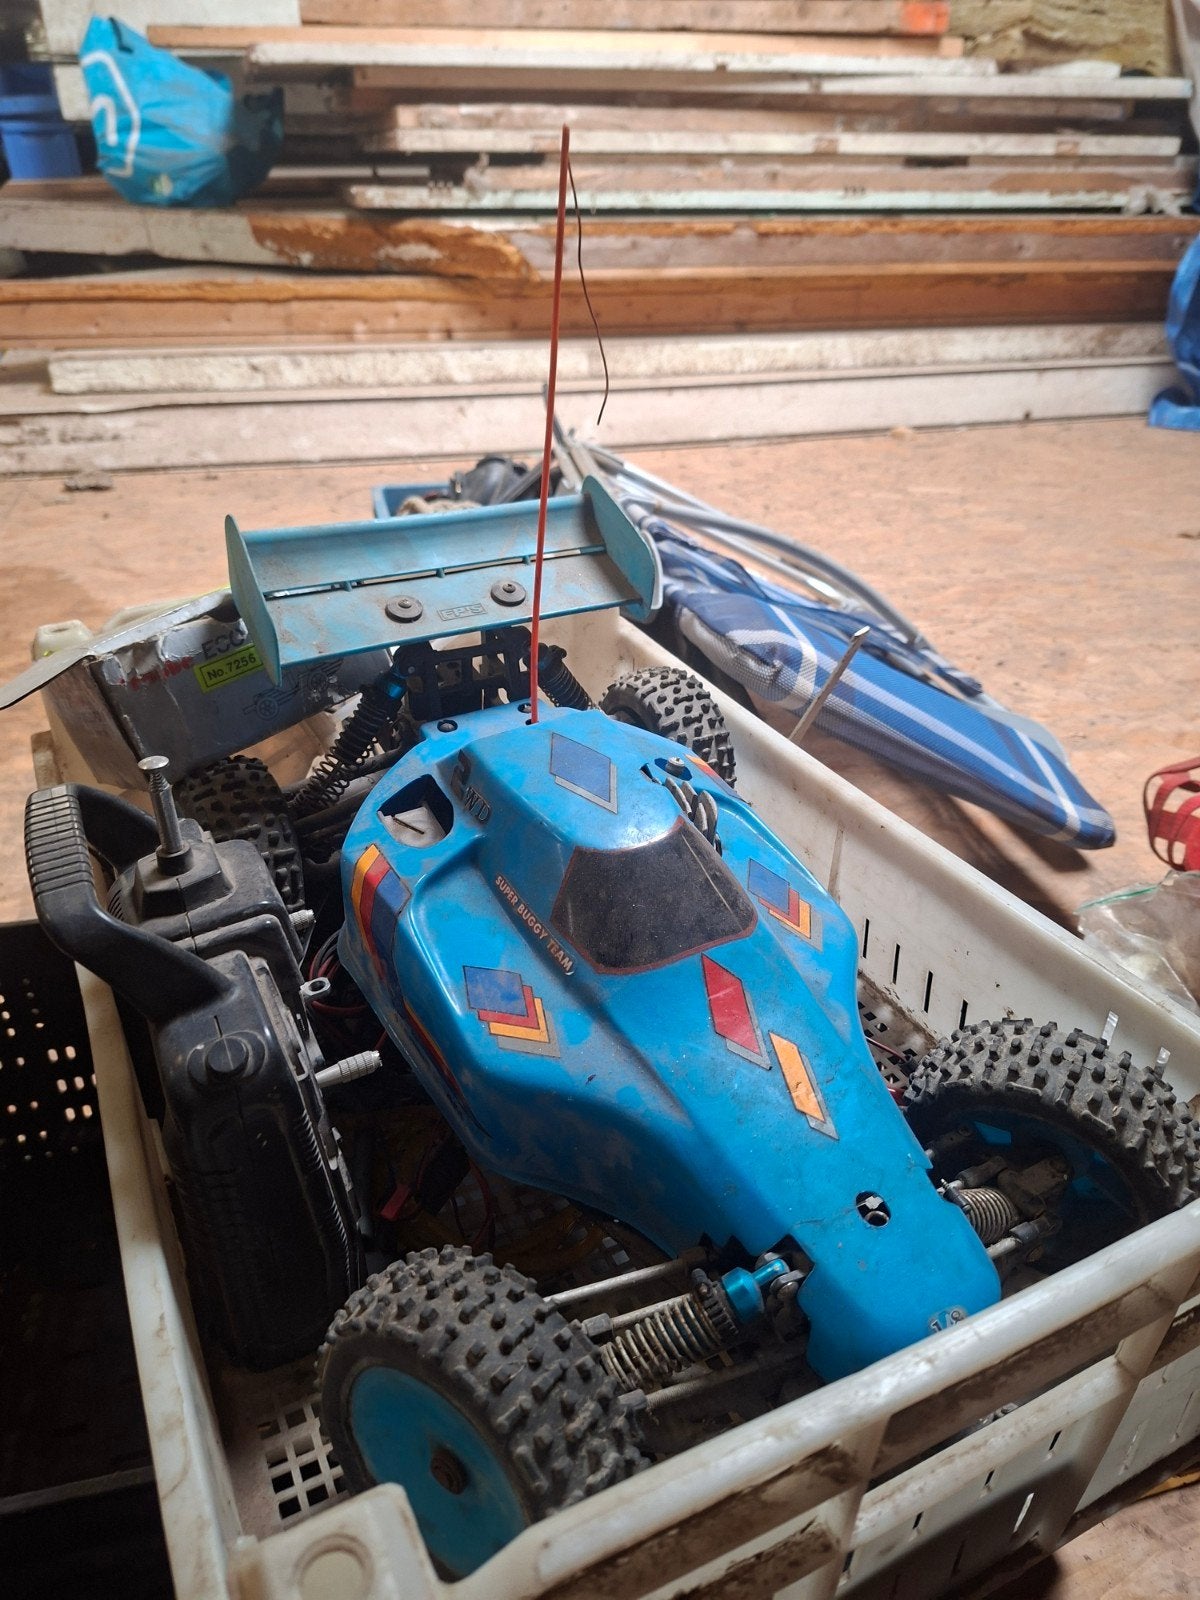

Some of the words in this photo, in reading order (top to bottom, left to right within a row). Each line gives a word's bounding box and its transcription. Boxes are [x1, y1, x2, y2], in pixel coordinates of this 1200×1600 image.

[495, 875, 519, 906] SUPER
[517, 903, 549, 940] BUGGY
[546, 938, 574, 973] TEAM
